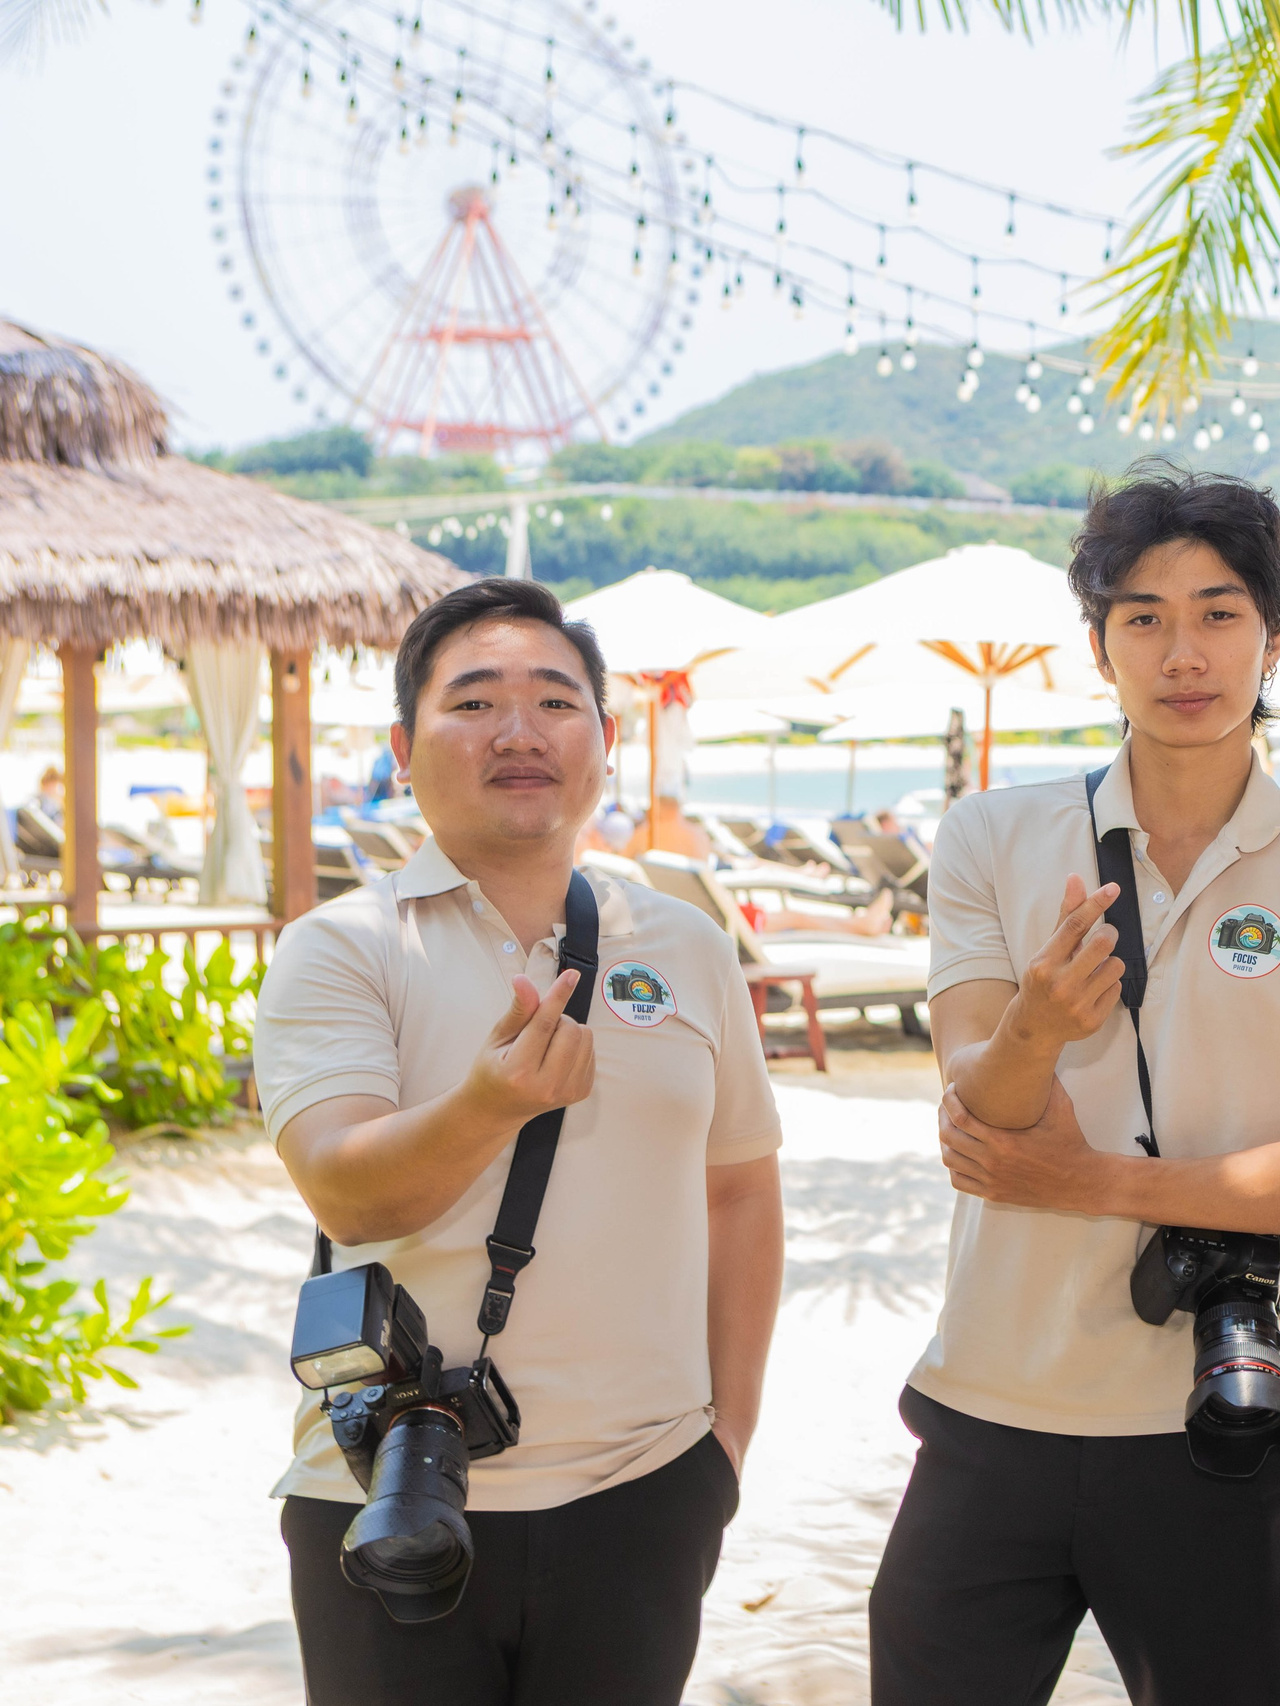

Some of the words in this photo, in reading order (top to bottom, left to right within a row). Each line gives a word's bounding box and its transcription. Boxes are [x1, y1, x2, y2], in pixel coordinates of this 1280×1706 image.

[1232, 952, 1258, 966] FOCUS
[1232, 964, 1253, 973] PHOTO
[632, 1003, 657, 1014] FOCUS
[1245, 1272, 1276, 1285] Canon
